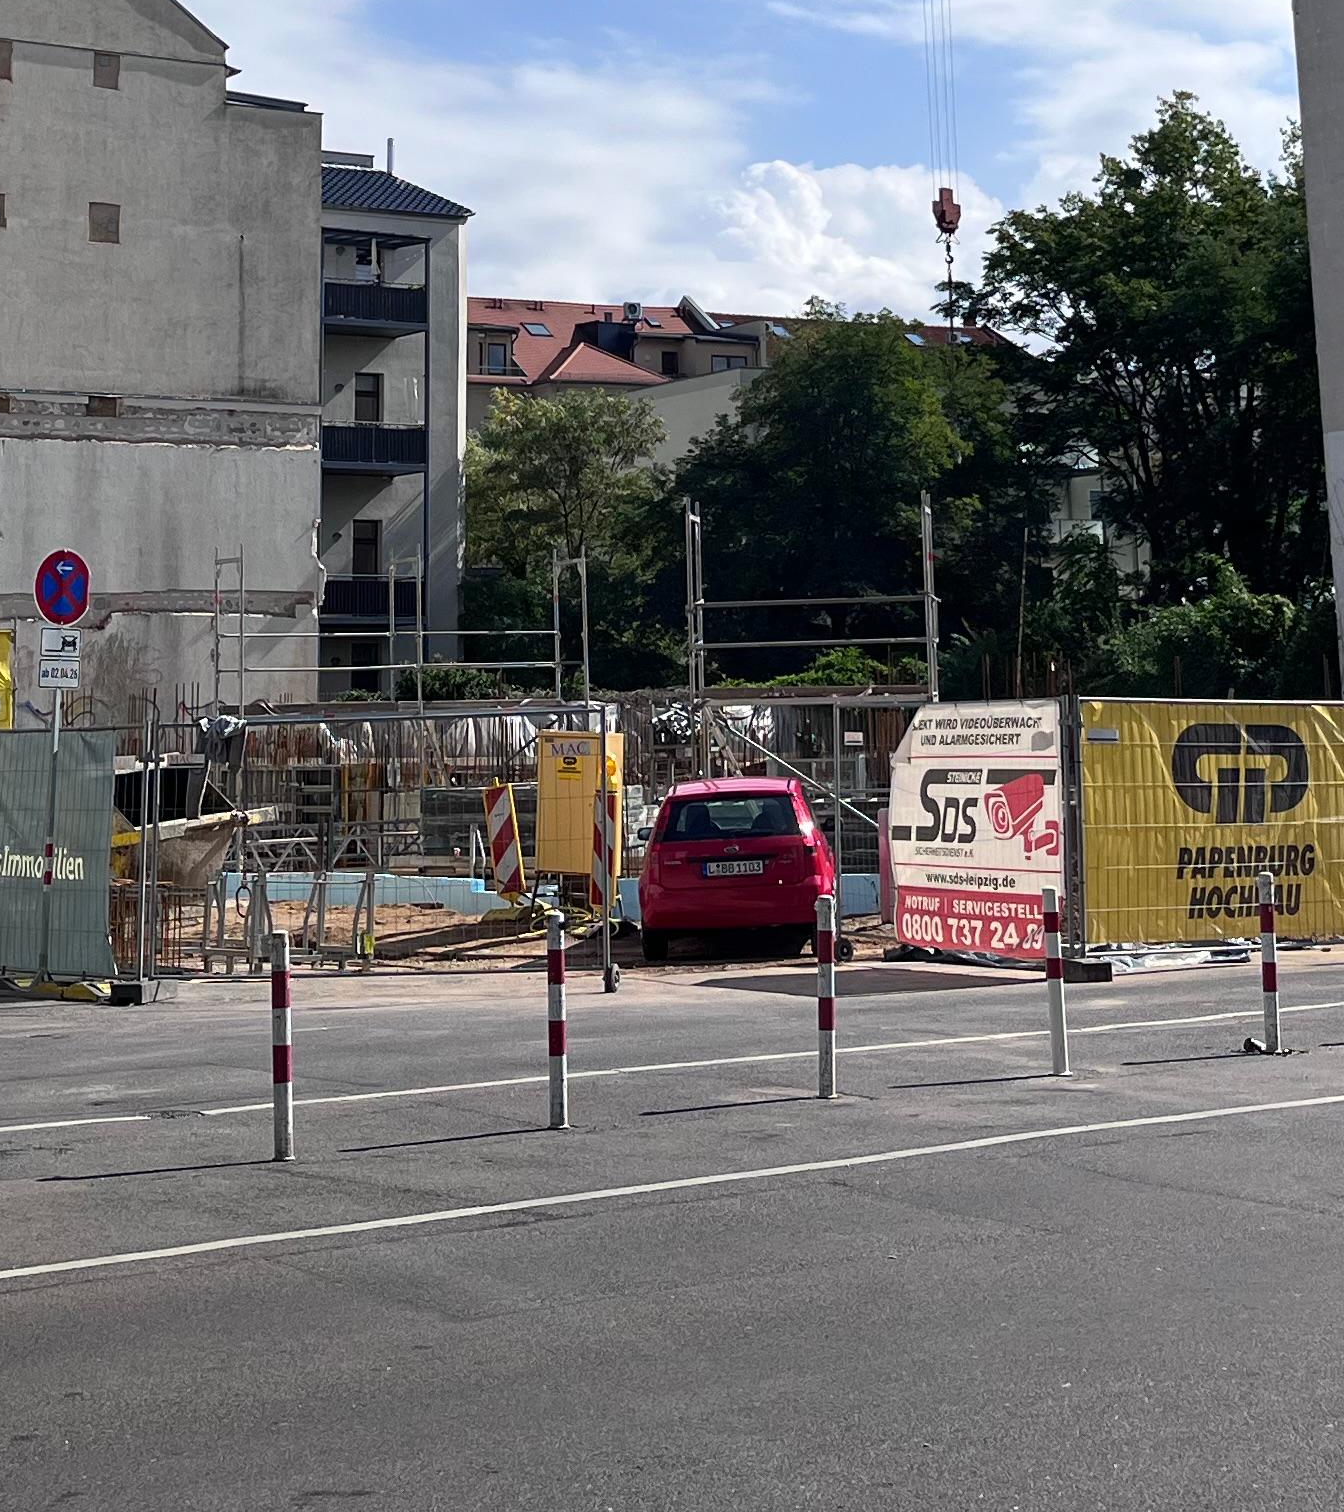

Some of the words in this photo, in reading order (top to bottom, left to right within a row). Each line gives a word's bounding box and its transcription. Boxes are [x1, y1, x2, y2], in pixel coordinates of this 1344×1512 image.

[41, 668, 49, 678] ab
[935, 718, 957, 730] WIRD
[960, 715, 1042, 730] VIDEOÜBERWACHT
[920, 734, 937, 746] UND
[939, 733, 1021, 746] ALARMGESICHERT
[708, 863, 714, 874] L
[736, 861, 762, 872] 1103
[1176, 844, 1315, 880] PAPENBURG
[926, 872, 1016, 890] www.sds-leipzig.de
[905, 895, 940, 912] NOTRUF
[953, 899, 1044, 920] SERVICESTELL
[1188, 883, 1302, 919] HOCHAU
[902, 912, 944, 943] 0800
[947, 917, 983, 947] 737
[989, 920, 1020, 949] 24
